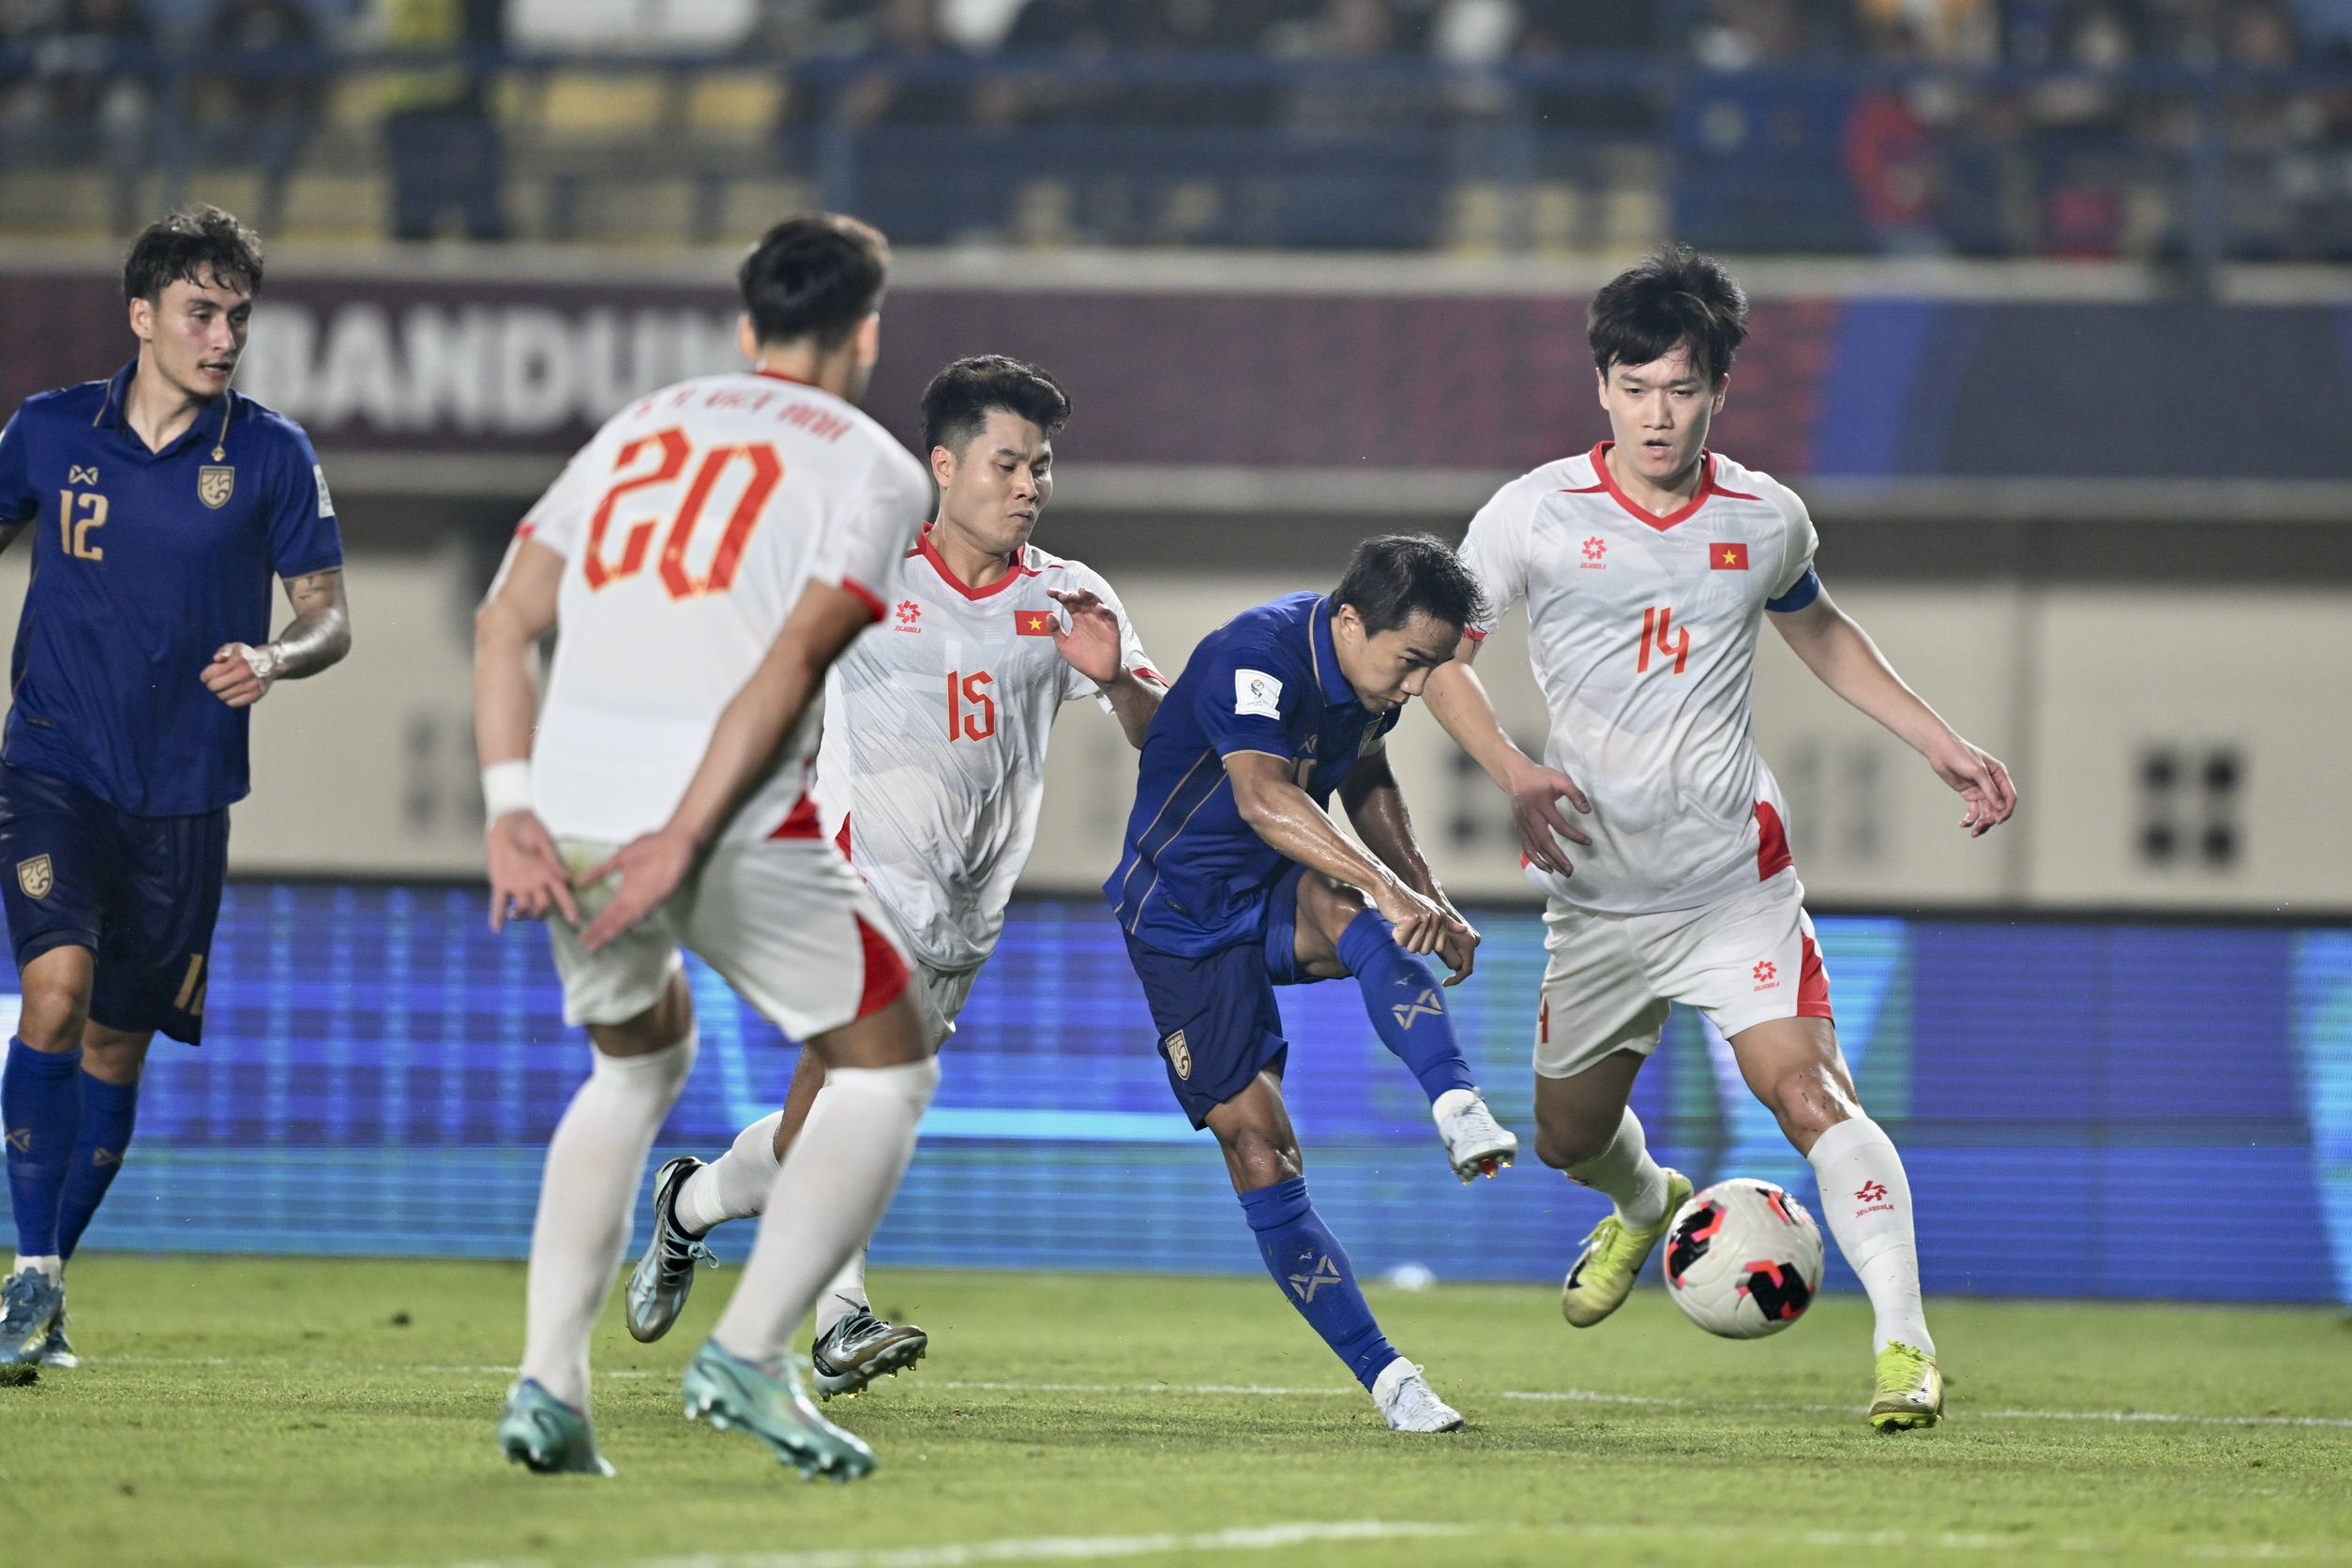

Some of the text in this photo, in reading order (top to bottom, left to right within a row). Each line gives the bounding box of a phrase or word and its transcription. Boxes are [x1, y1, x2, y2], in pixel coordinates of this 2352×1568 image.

[60, 490, 109, 562] 12
[583, 424, 786, 604] 20
[1636, 606, 1692, 676] 14
[946, 670, 996, 744] 15
